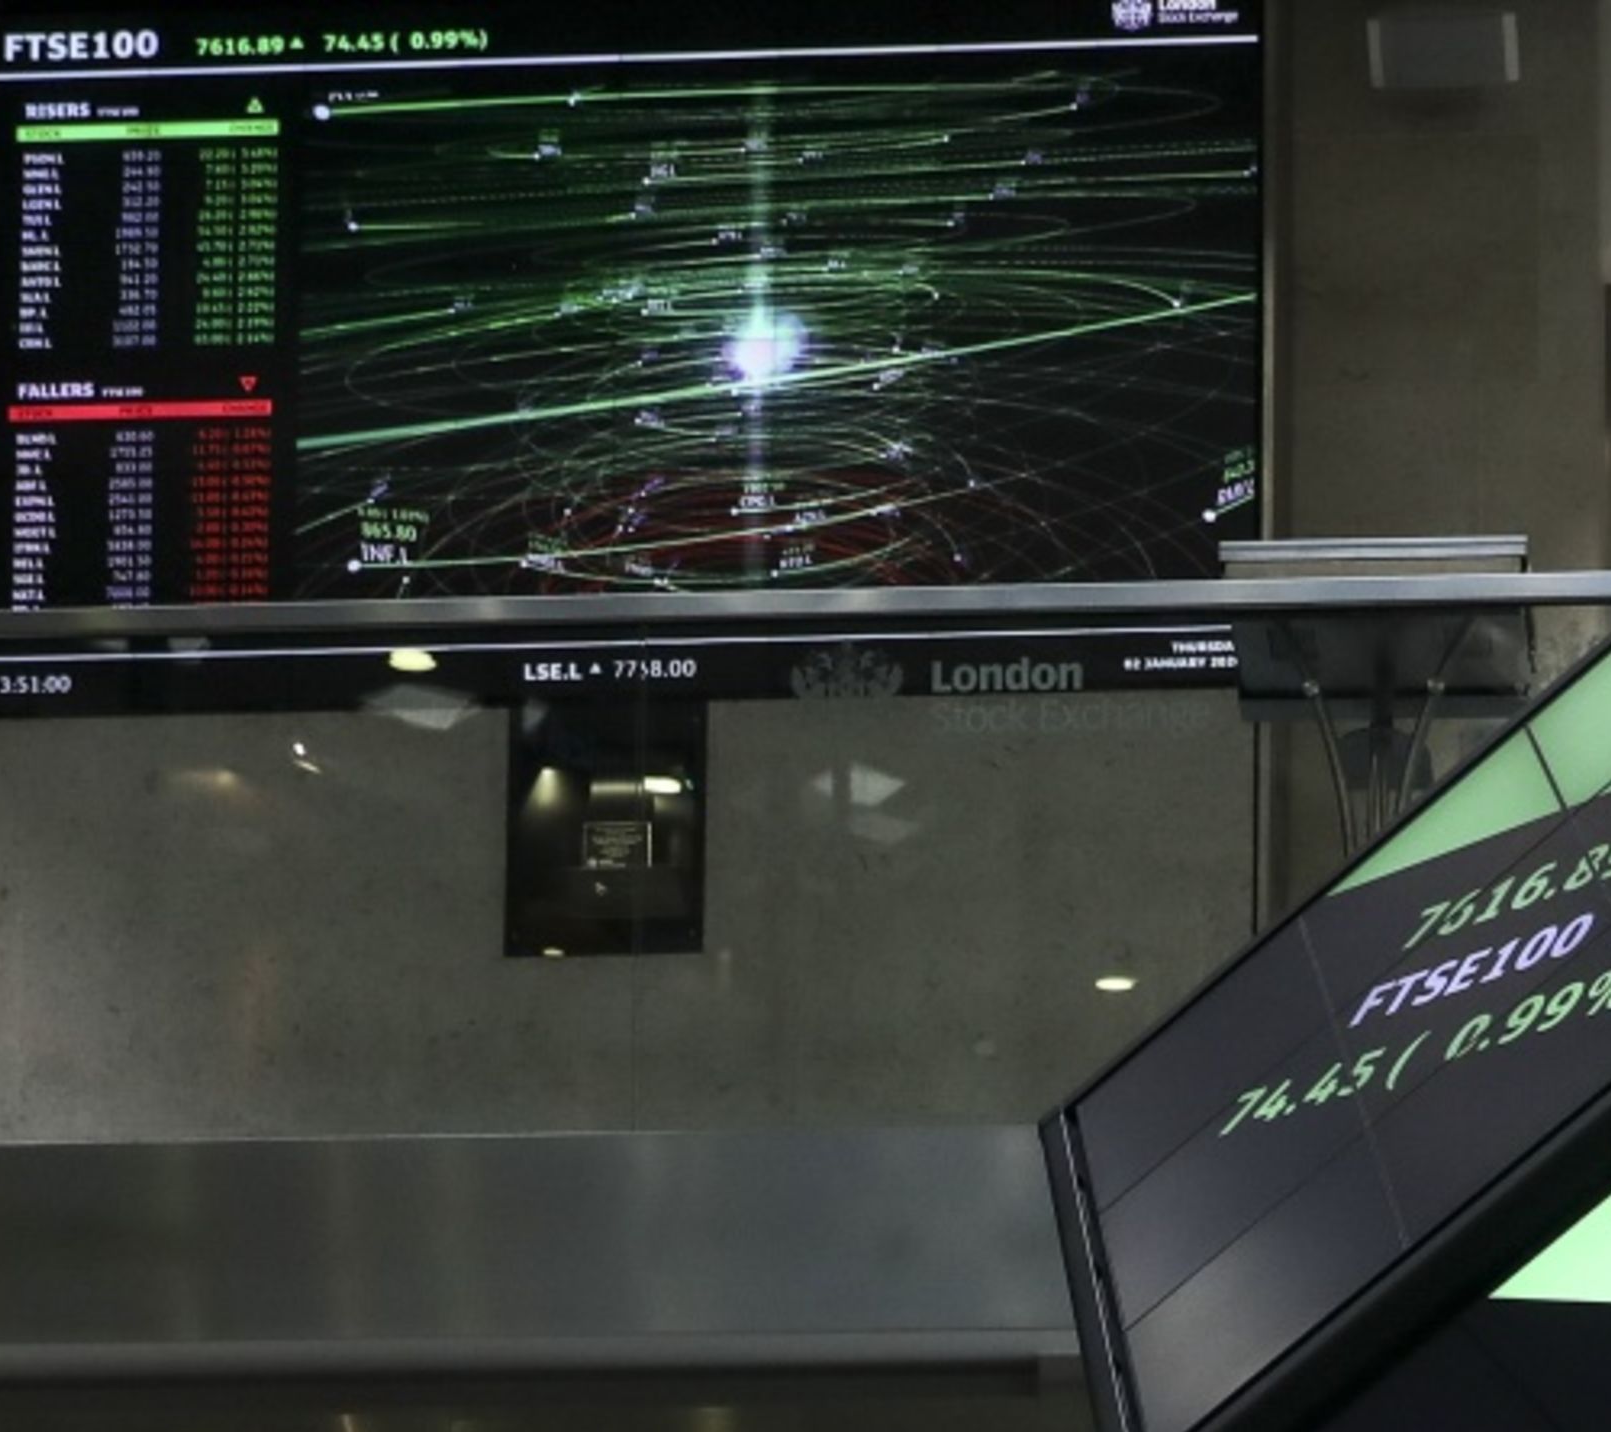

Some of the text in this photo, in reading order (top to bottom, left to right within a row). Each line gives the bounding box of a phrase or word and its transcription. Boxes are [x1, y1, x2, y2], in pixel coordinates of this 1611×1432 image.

[5, 30, 158, 61] FTSE100
[197, 36, 284, 55] 7616.89
[324, 33, 384, 51] 74.45
[410, 30, 487, 49] 0.99%)
[25, 103, 89, 119] RISERS
[18, 383, 94, 399] FALLERS
[1172, 640, 1235, 653] THURSDA
[525, 663, 581, 680] LSE.L
[930, 656, 1083, 692] London
[1348, 914, 1594, 1028] FTSE100
[1218, 1049, 1385, 1138] 74.45
